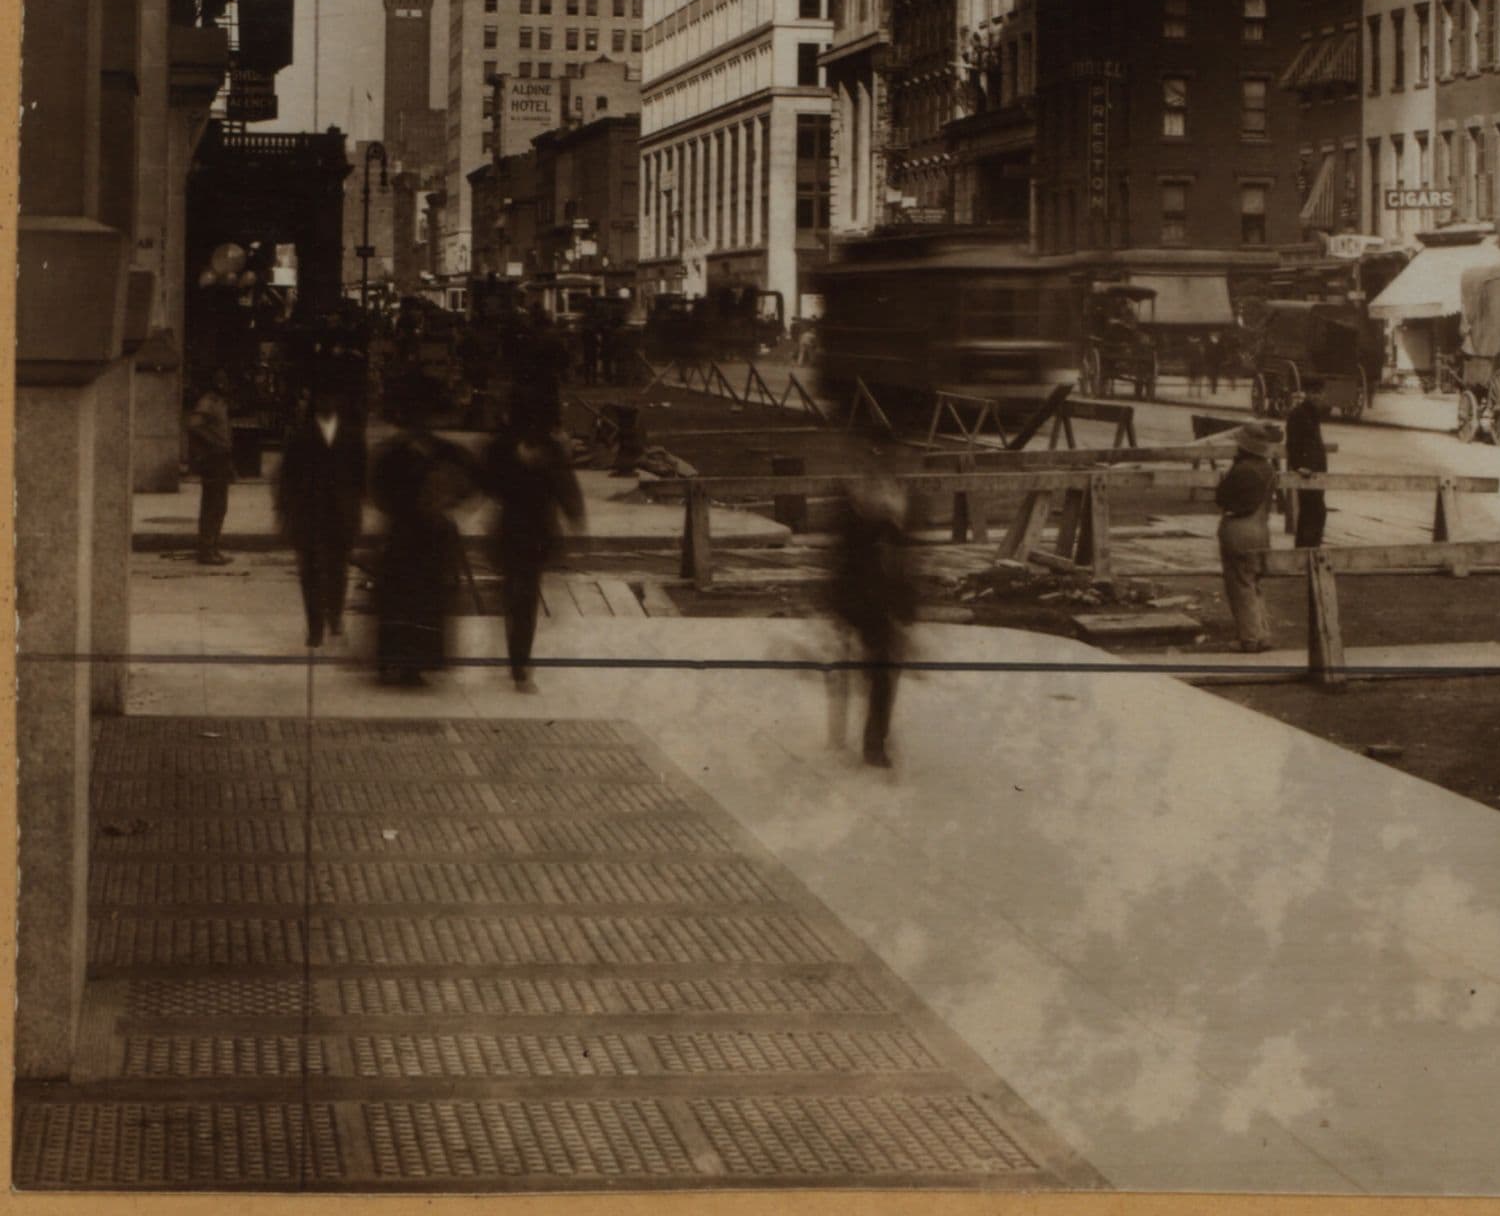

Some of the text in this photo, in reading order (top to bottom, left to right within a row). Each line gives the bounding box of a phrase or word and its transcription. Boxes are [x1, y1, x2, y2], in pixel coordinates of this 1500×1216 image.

[511, 99, 552, 113] HOTEL
[1091, 85, 1105, 209] PRESTON
[1387, 191, 1455, 207] CIGARS
